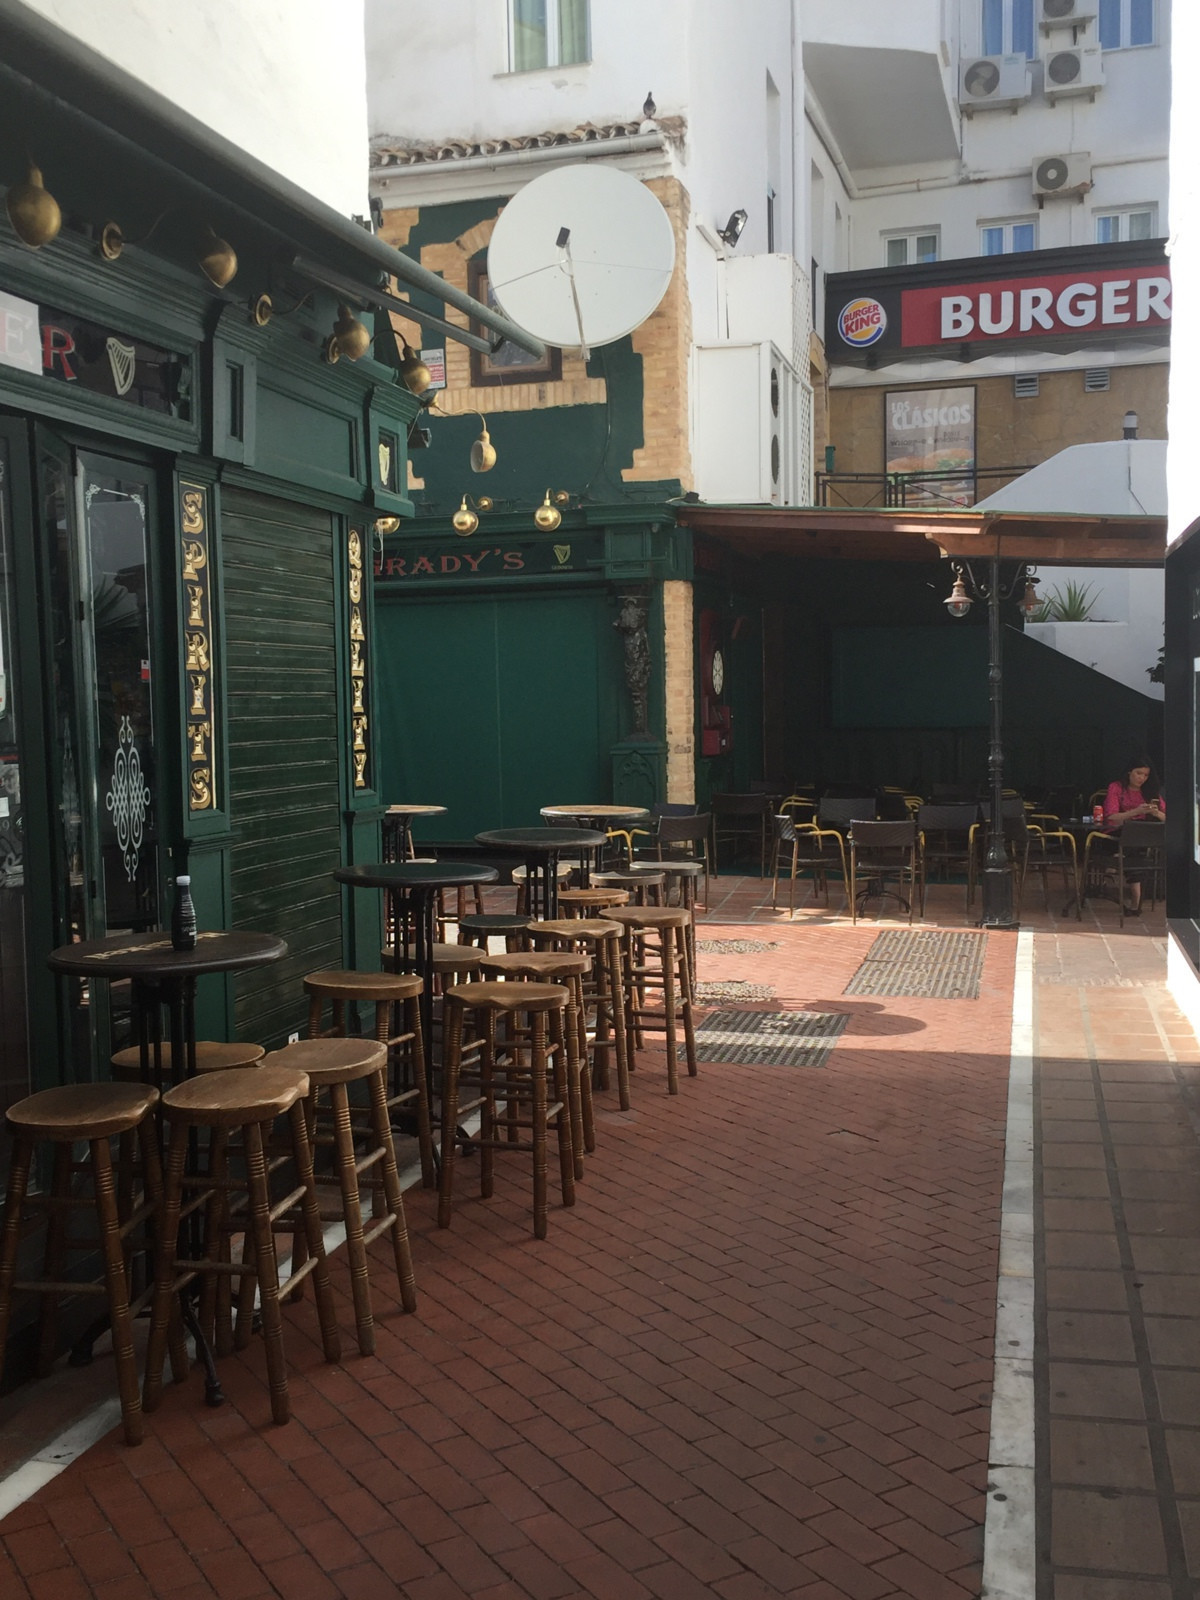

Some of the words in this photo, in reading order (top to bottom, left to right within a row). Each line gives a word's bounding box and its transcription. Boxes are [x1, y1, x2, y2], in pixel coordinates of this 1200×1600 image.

[844, 304, 879, 325] BURGER
[941, 277, 1171, 338] BURGER
[845, 313, 880, 336] KING
[892, 401, 910, 413] LOS
[892, 404, 971, 430] CLÁSICOS
[182, 491, 212, 810] SPIRITS
[349, 530, 367, 786] QUALITY
